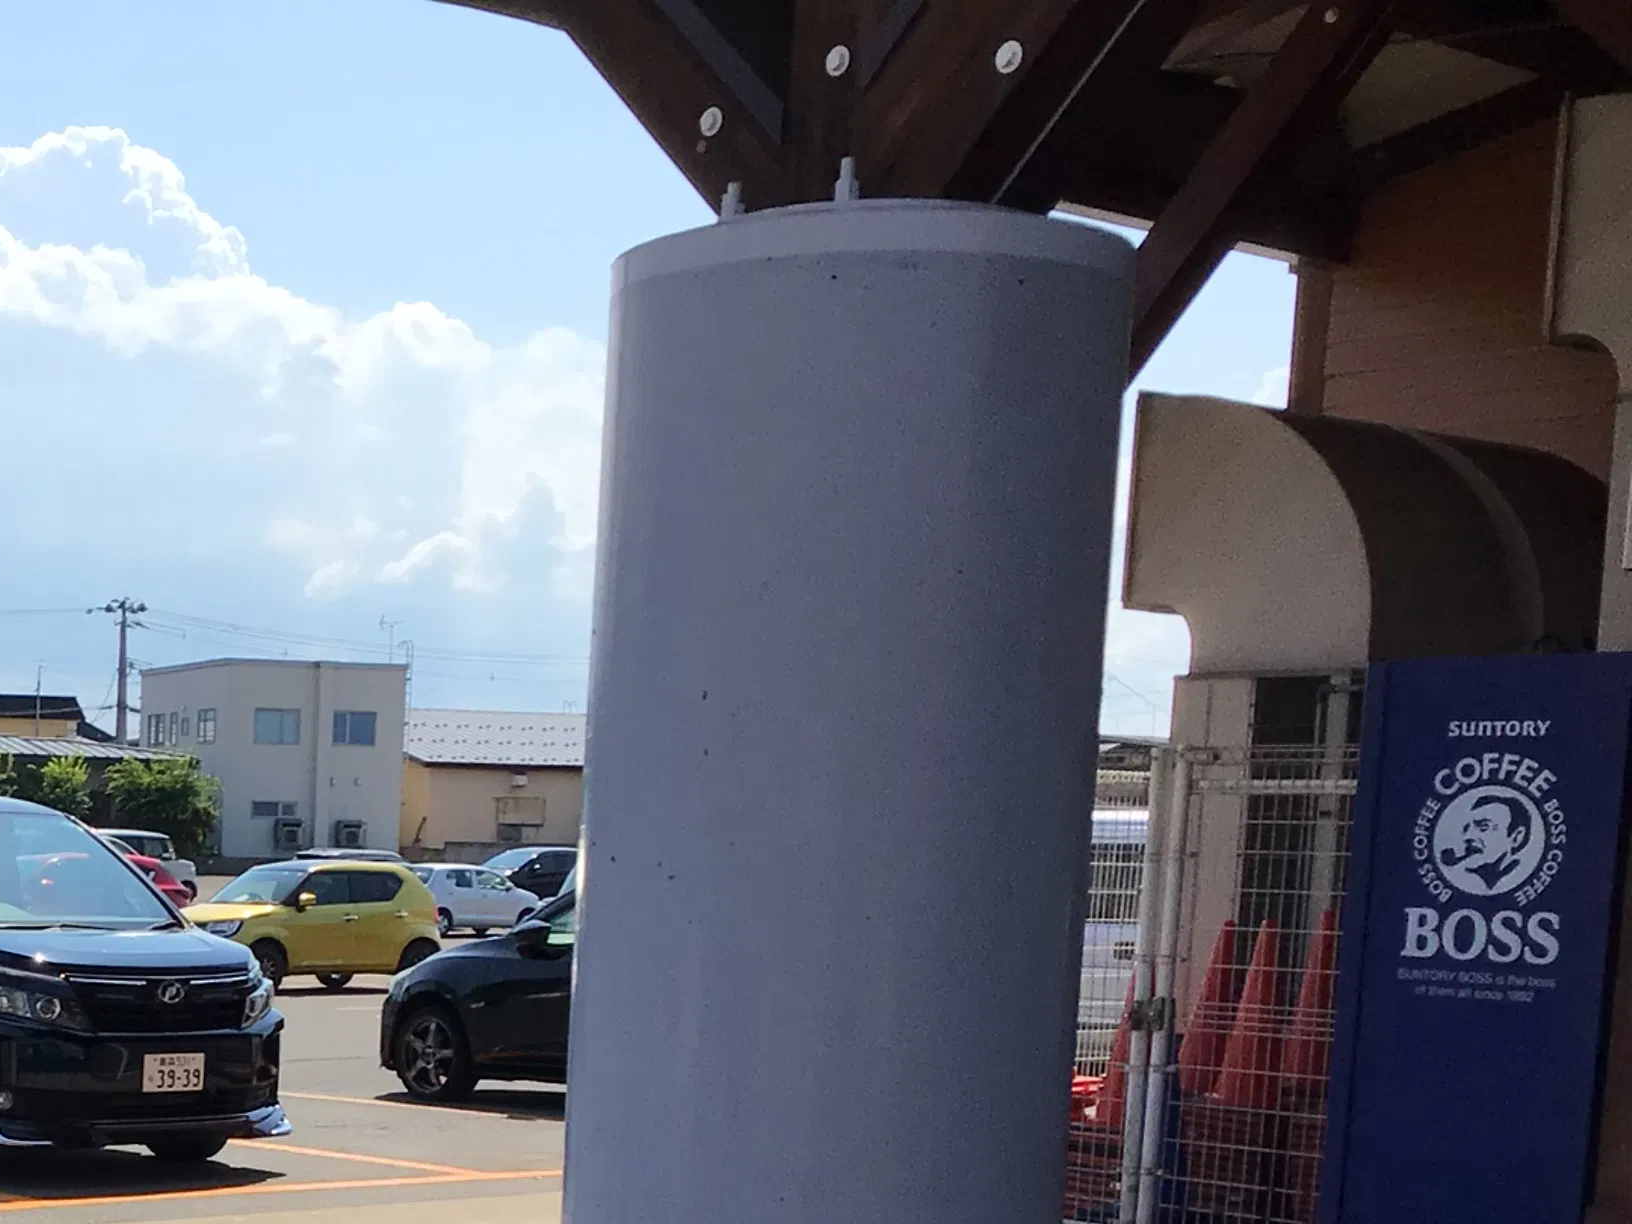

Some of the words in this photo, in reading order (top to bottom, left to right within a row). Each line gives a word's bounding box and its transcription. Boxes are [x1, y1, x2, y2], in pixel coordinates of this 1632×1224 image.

[1448, 720, 1551, 737] SUNTORY
[1434, 753, 1557, 798] COFFEE
[1414, 797, 1441, 860] COFFEE
[1544, 798, 1567, 844] BOSS
[1418, 863, 1453, 903] BOSS
[1514, 850, 1563, 907] COFFEE
[1400, 907, 1561, 965] BOSS
[1397, 967, 1457, 981] SUNTORY
[1458, 971, 1493, 984] BOSS
[156, 1068, 201, 1088] 39-39
